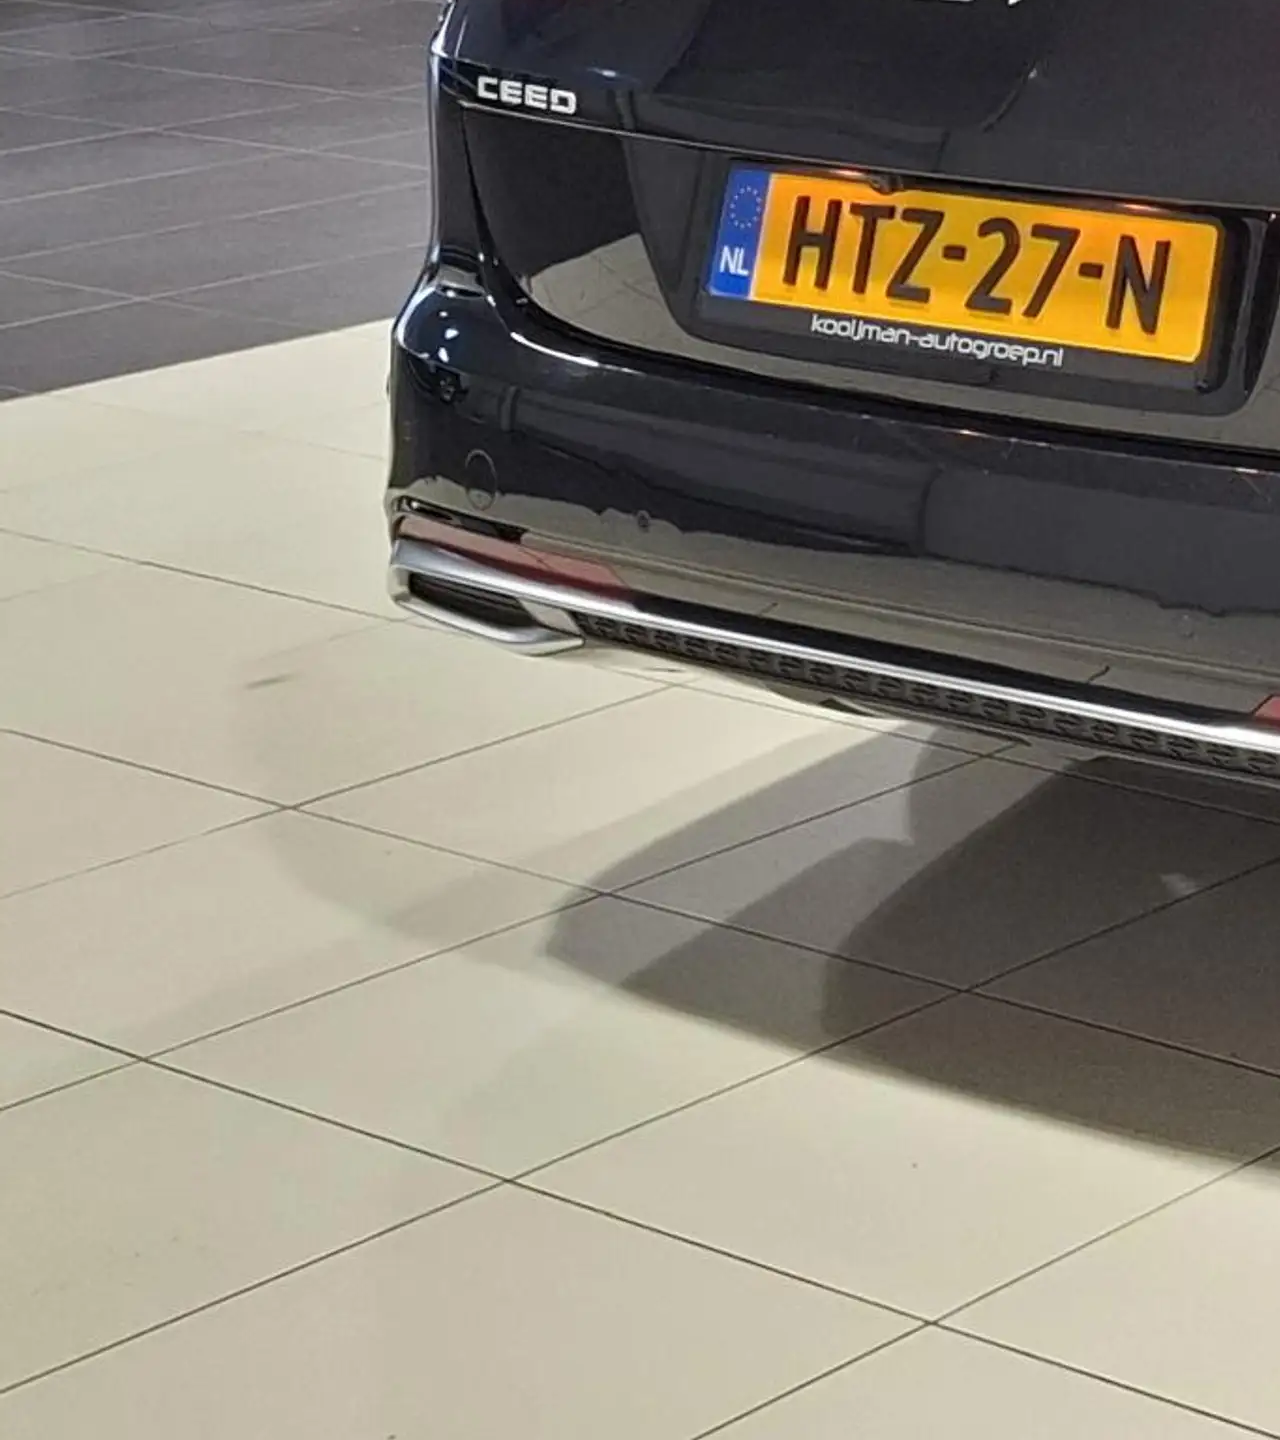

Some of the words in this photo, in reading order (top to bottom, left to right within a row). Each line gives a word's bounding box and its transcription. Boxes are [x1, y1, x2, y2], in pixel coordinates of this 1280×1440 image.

[477, 75, 577, 115] CEED
[719, 245, 749, 277] NL
[782, 194, 1172, 337] HTZ-27-N
[810, 313, 1064, 367] kooijman-autogroep.nl
